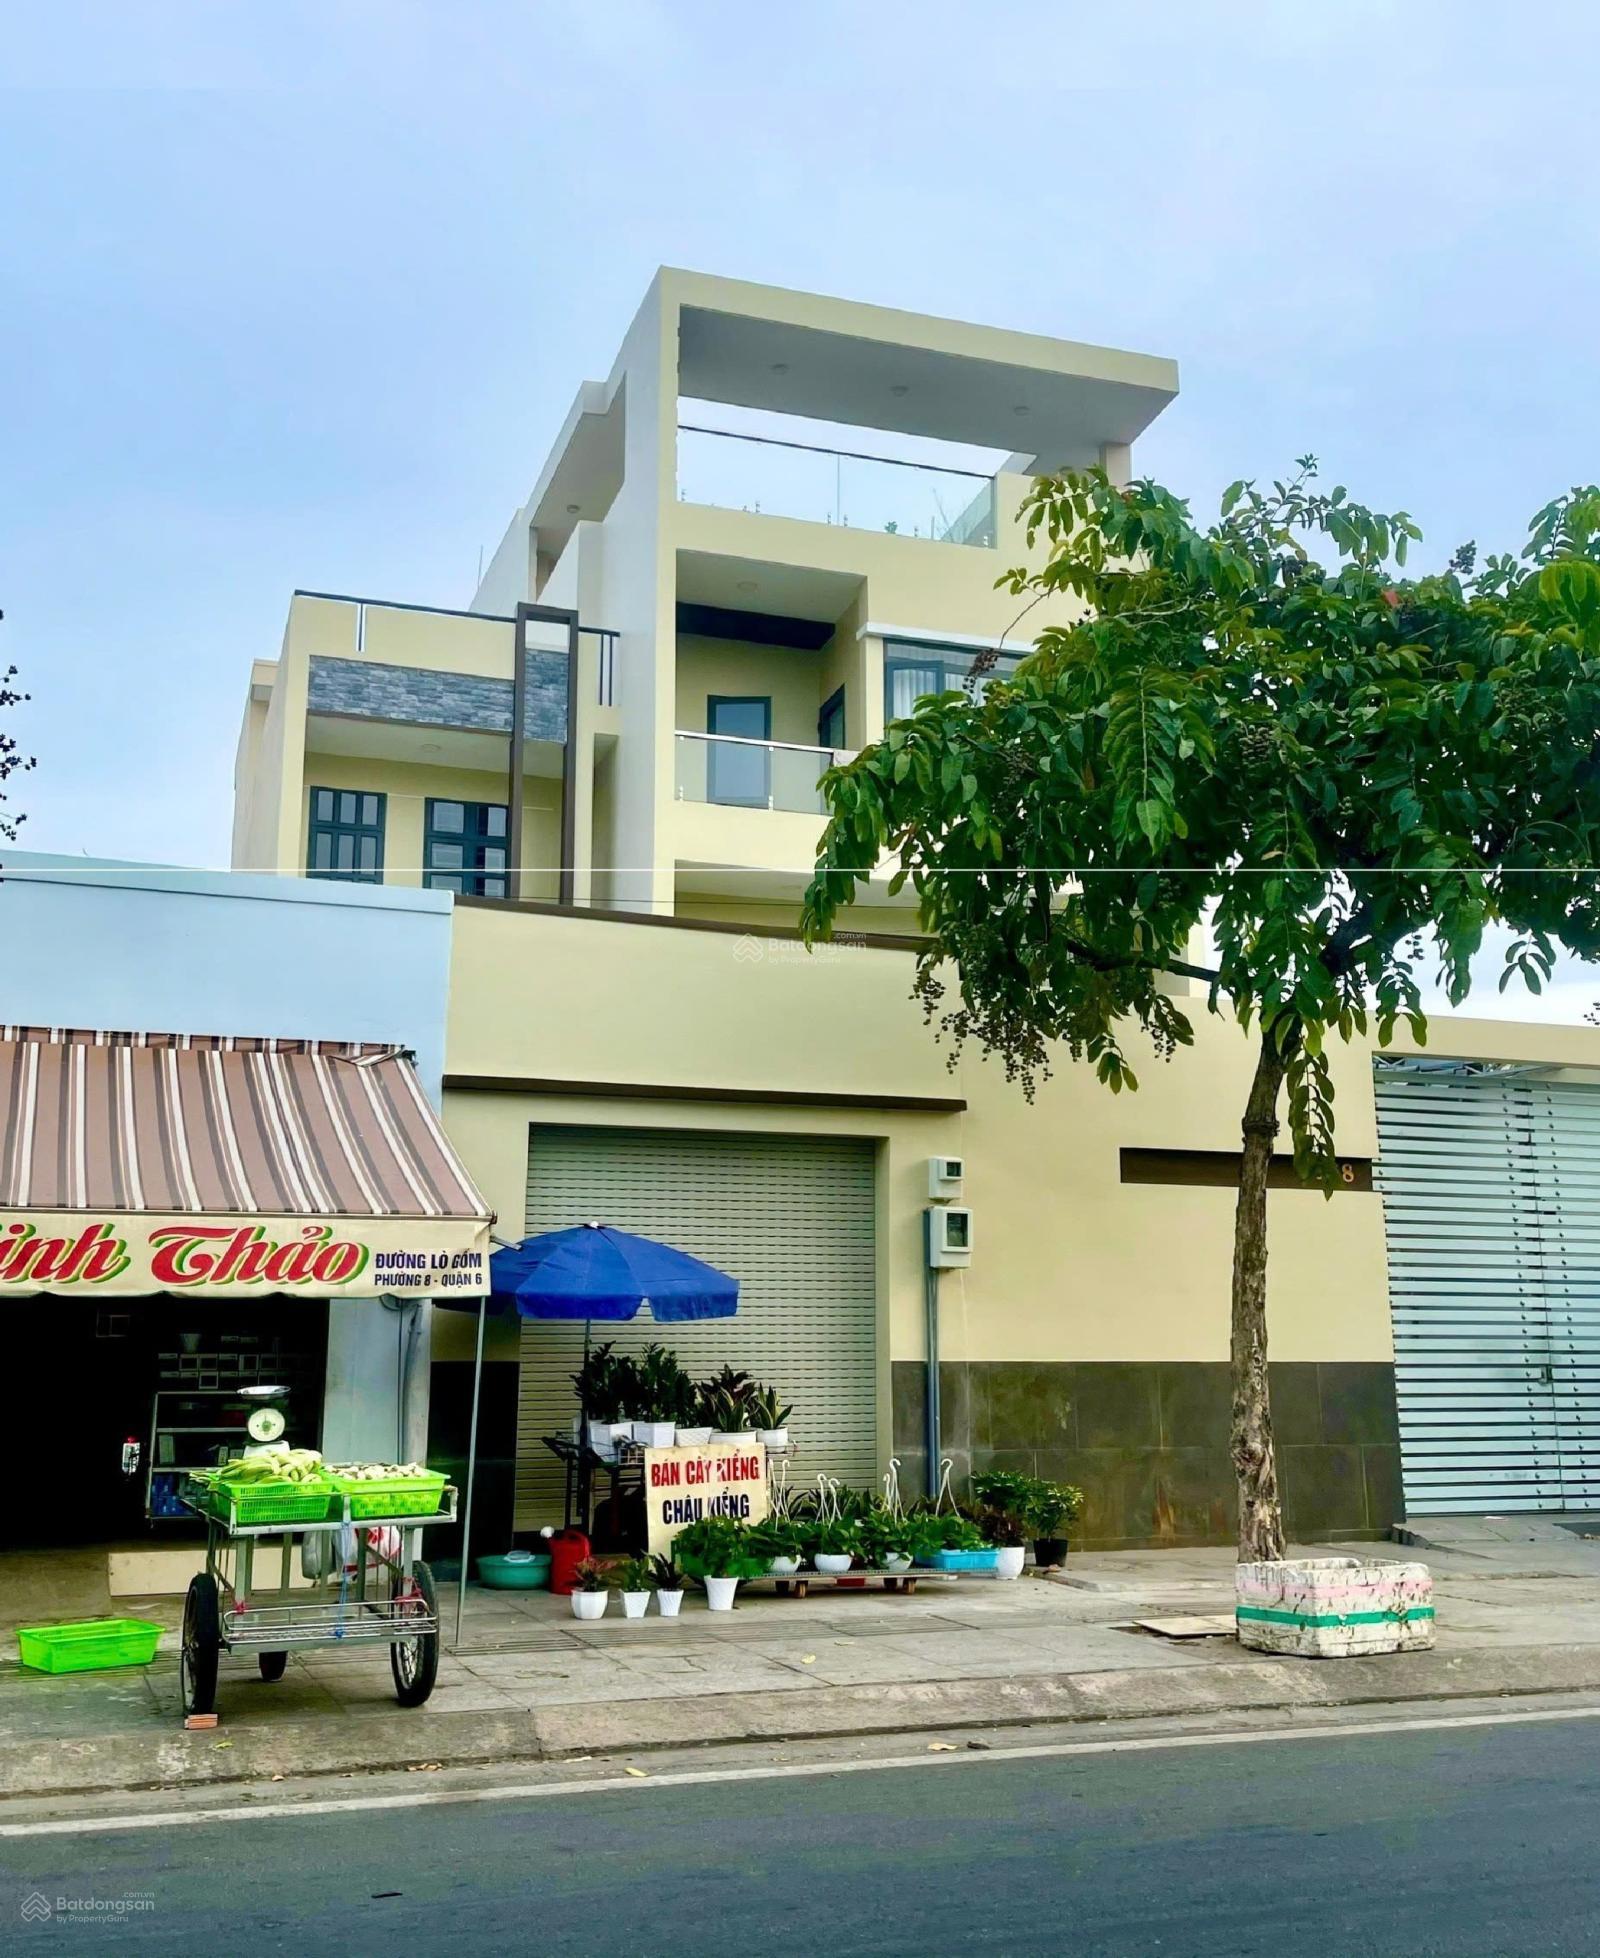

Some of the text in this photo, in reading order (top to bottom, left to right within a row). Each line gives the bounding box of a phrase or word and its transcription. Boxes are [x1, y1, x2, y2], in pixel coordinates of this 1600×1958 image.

[0, 1222, 370, 1287] inh Thảo
[375, 1248, 482, 1269] ĐƯỜNG LÒ GỐM
[375, 1271, 421, 1286] PHƯỜNG
[424, 1275, 431, 1286] 8
[441, 1271, 471, 1289] QUẬN
[476, 1273, 482, 1284] 6
[651, 1458, 680, 1487] BÁN
[685, 1455, 712, 1485] CÂY
